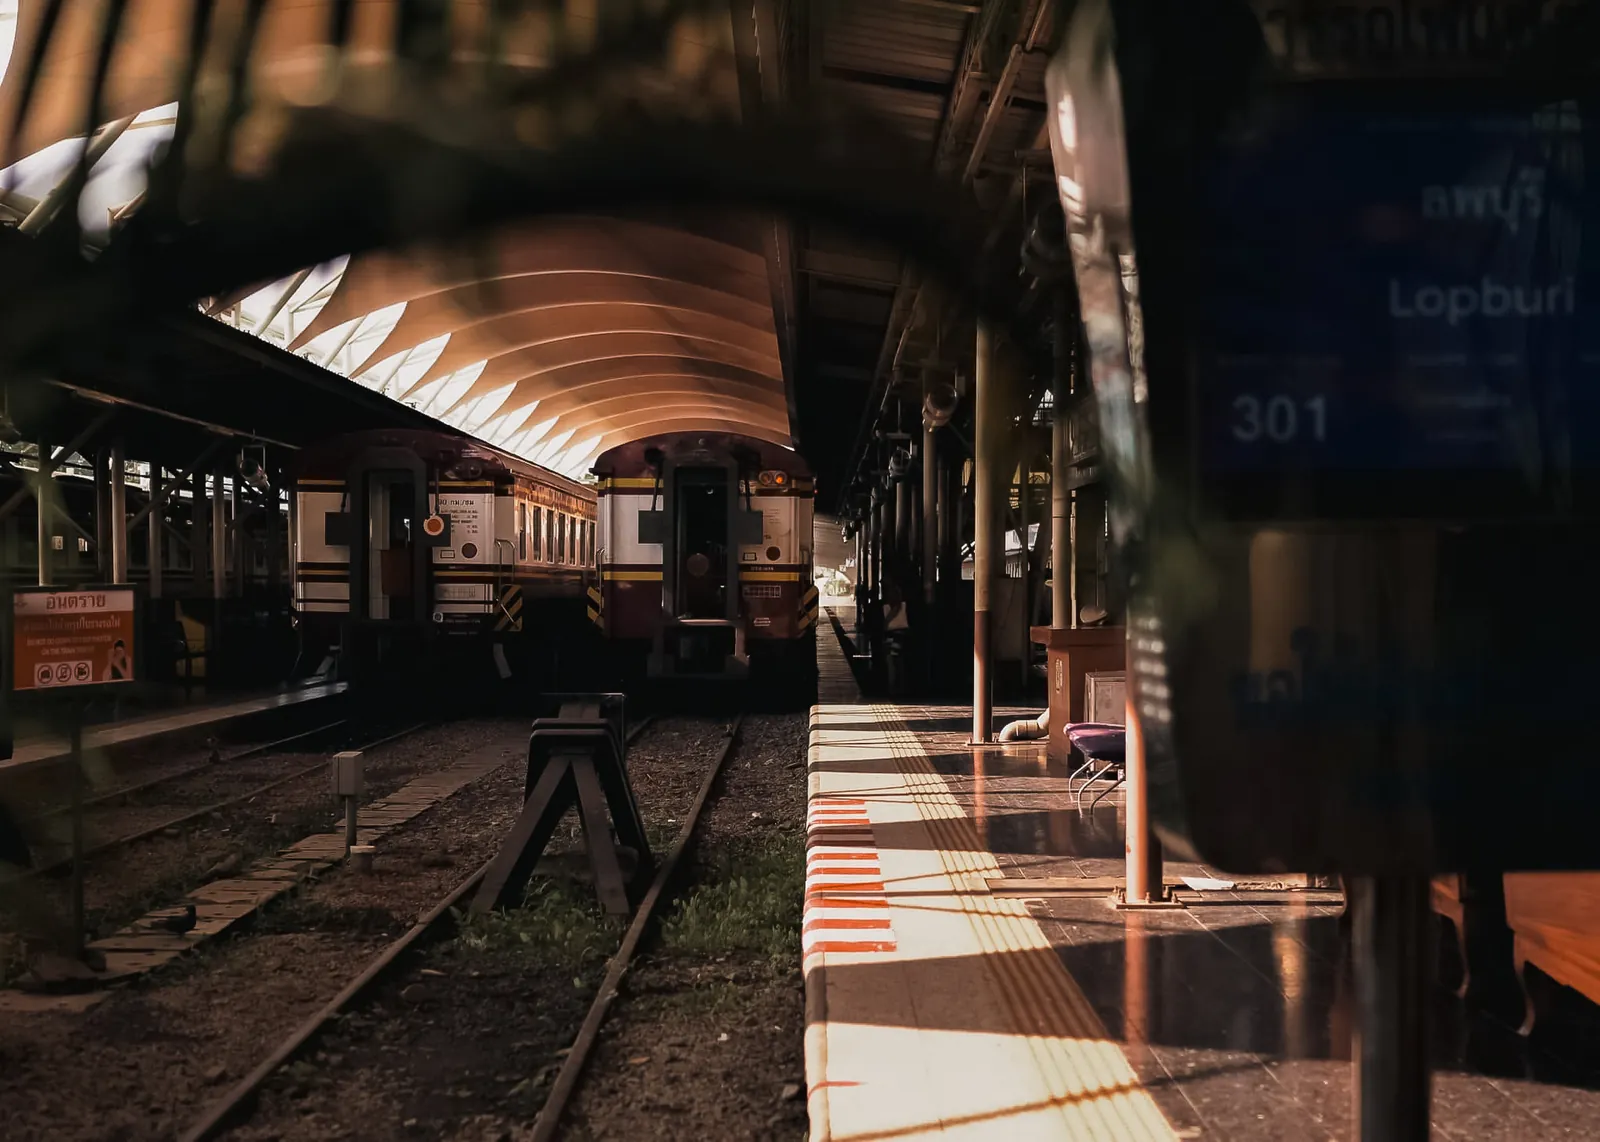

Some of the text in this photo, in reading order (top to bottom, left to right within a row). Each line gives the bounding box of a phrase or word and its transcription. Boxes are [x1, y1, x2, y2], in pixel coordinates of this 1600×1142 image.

[1421, 165, 1547, 236] ลพบุรี
[1388, 273, 1576, 327] Lopburi
[1231, 393, 1327, 443] 301
[45, 592, 106, 610] อันตราย
